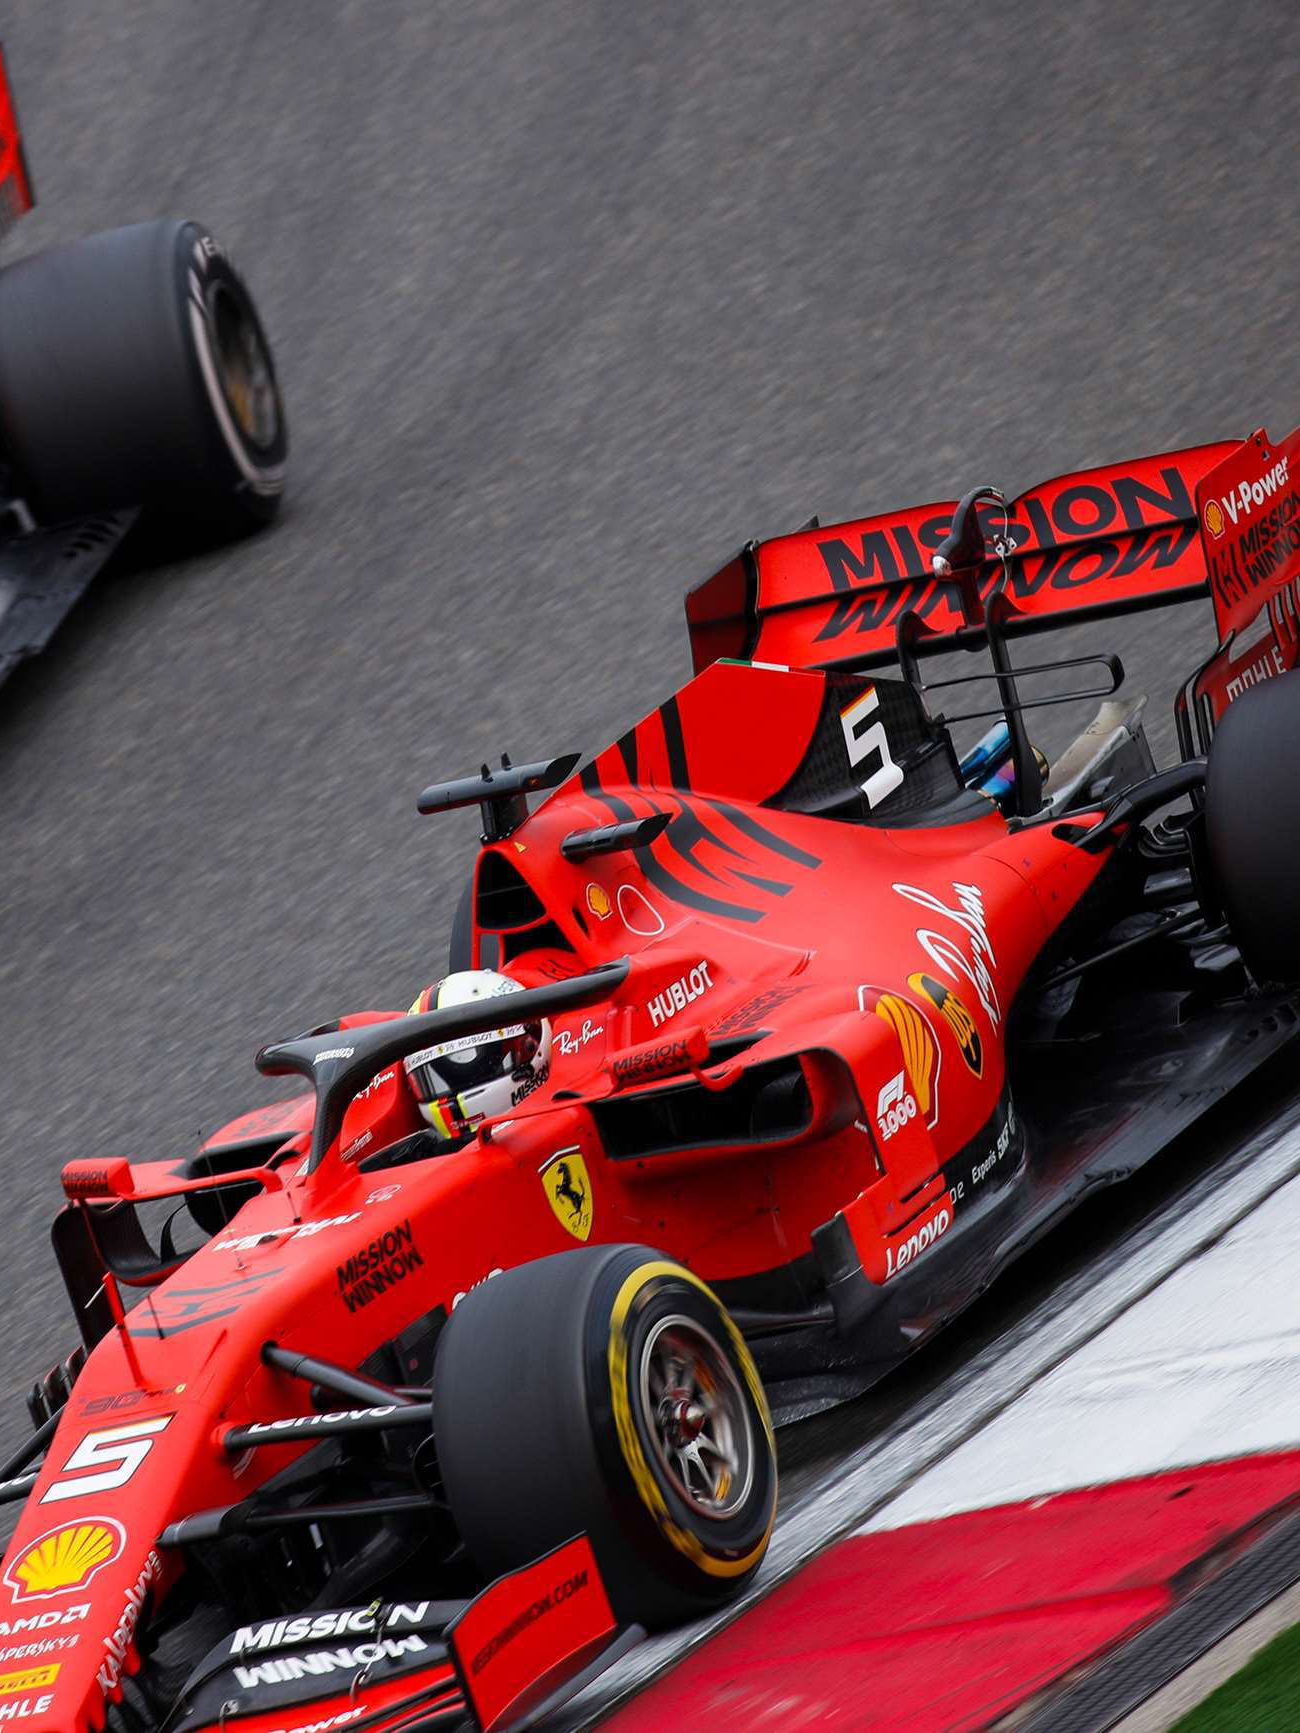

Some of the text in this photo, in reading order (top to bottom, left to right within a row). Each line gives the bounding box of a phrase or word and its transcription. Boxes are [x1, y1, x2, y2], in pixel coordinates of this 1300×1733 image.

[1221, 456, 1290, 525] V-Power
[840, 684, 905, 810] 5
[647, 960, 715, 1028] HUBLOT
[552, 1019, 604, 1055] Ray-Ban
[336, 1218, 414, 1291] MISSION
[885, 1208, 950, 1280] Lenovo
[342, 1245, 425, 1313] WINNOW
[247, 1405, 398, 1434] Lenovo
[38, 1410, 177, 1505] 5
[232, 1634, 428, 1689] WINNOW
